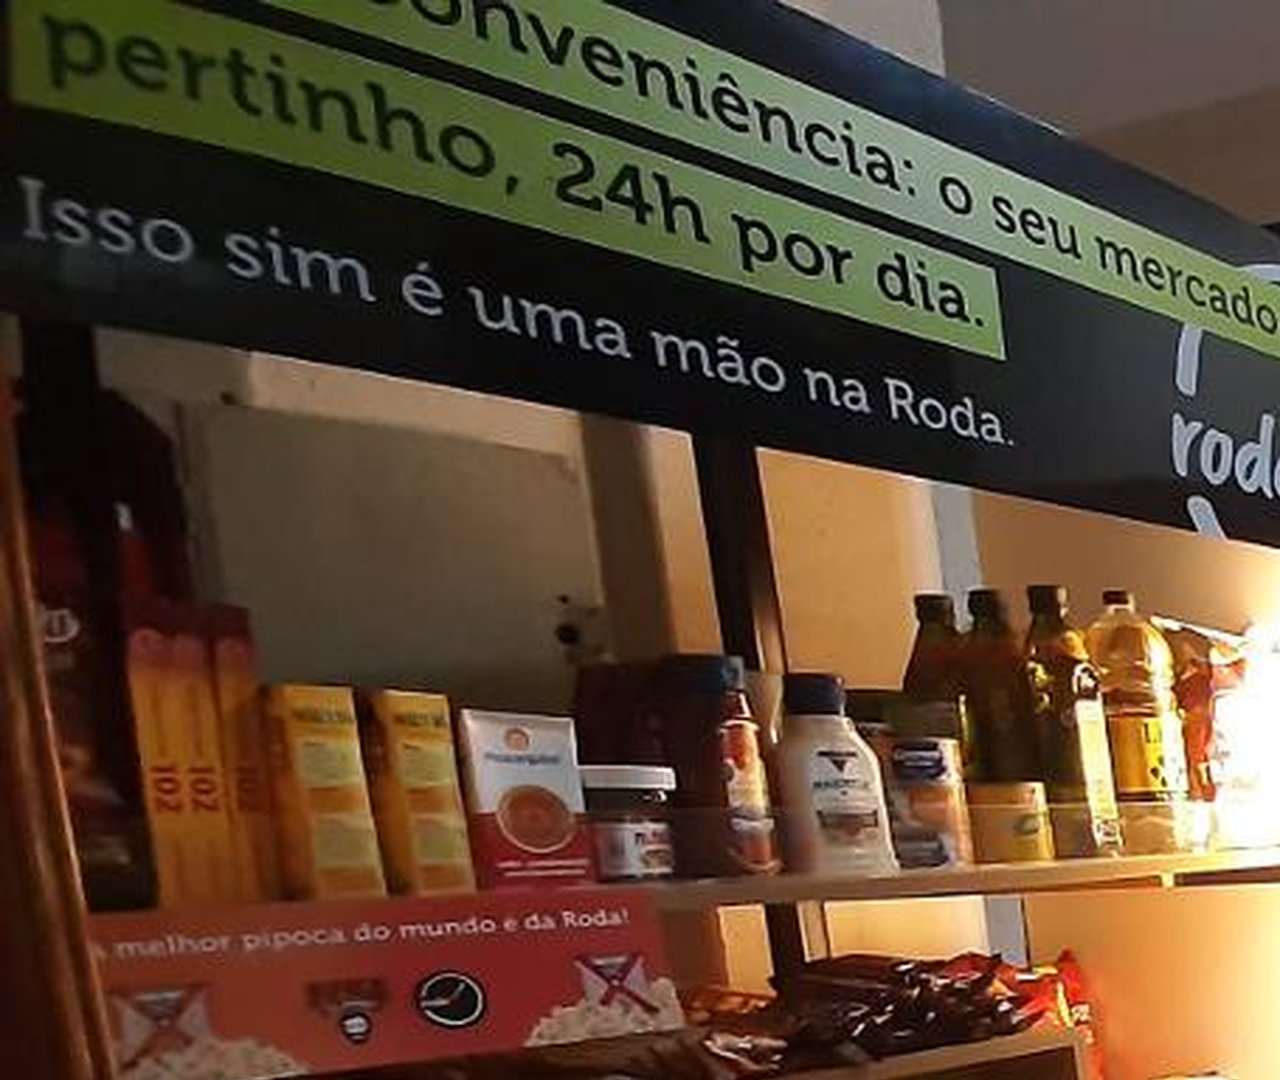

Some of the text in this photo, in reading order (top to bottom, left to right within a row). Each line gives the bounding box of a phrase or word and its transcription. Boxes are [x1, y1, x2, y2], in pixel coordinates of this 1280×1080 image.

[42, 15, 985, 326] pertinho, 24h por dia.
[938, 174, 973, 214] o
[991, 196, 1083, 262] seu
[17, 176, 1015, 446] Isso sim é uma mão na Roda.
[113, 934, 230, 958] melhor
[241, 928, 346, 953] pipoca
[354, 924, 391, 942] do
[400, 916, 497, 939] mundo
[524, 913, 556, 931] da
[562, 908, 630, 929] Roda!
